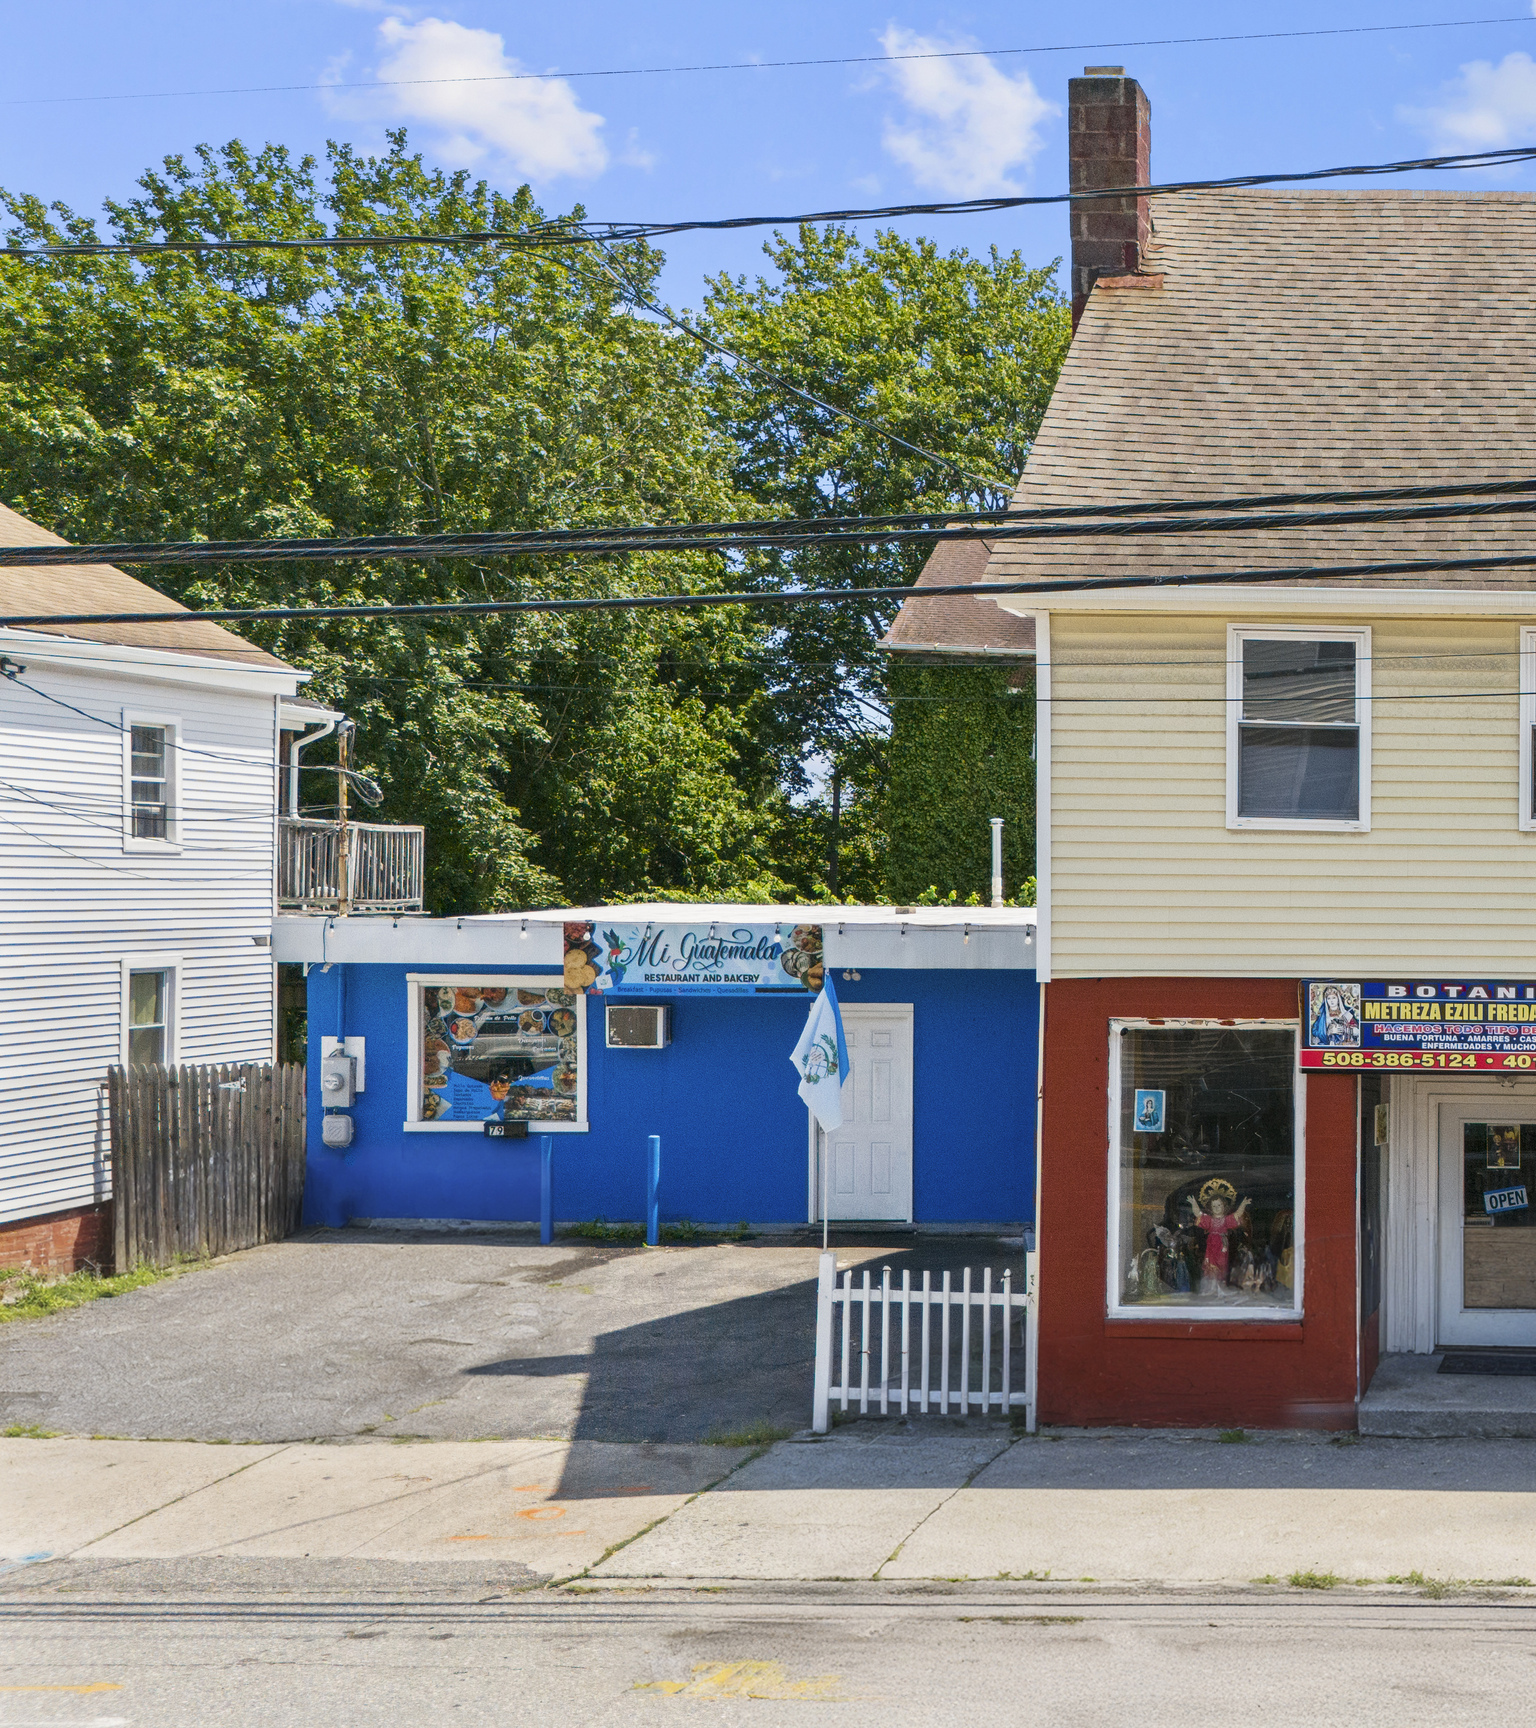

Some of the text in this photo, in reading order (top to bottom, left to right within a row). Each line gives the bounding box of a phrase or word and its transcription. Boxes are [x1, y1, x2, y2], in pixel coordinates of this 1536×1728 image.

[621, 928, 777, 972] Mi Guatemala
[644, 974, 760, 983] RESTAURANT AND BAKERY
[1364, 1002, 1441, 1021] METREZA
[1445, 1003, 1485, 1022] EZILI
[1374, 1024, 1442, 1035] HACEMOS
[1444, 1025, 1483, 1035] TODO
[1485, 1025, 1519, 1036] TIPO
[1417, 1034, 1458, 1042] FORTUNA
[1467, 1035, 1510, 1043] AMARRES
[1421, 1042, 1493, 1050] ENFERMEDADES
[1503, 1043, 1536, 1051] MUCHO
[1322, 1052, 1477, 1068] 508-386-5124
[490, 1126, 503, 1135] 79
[1489, 1190, 1525, 1210] OPEN
